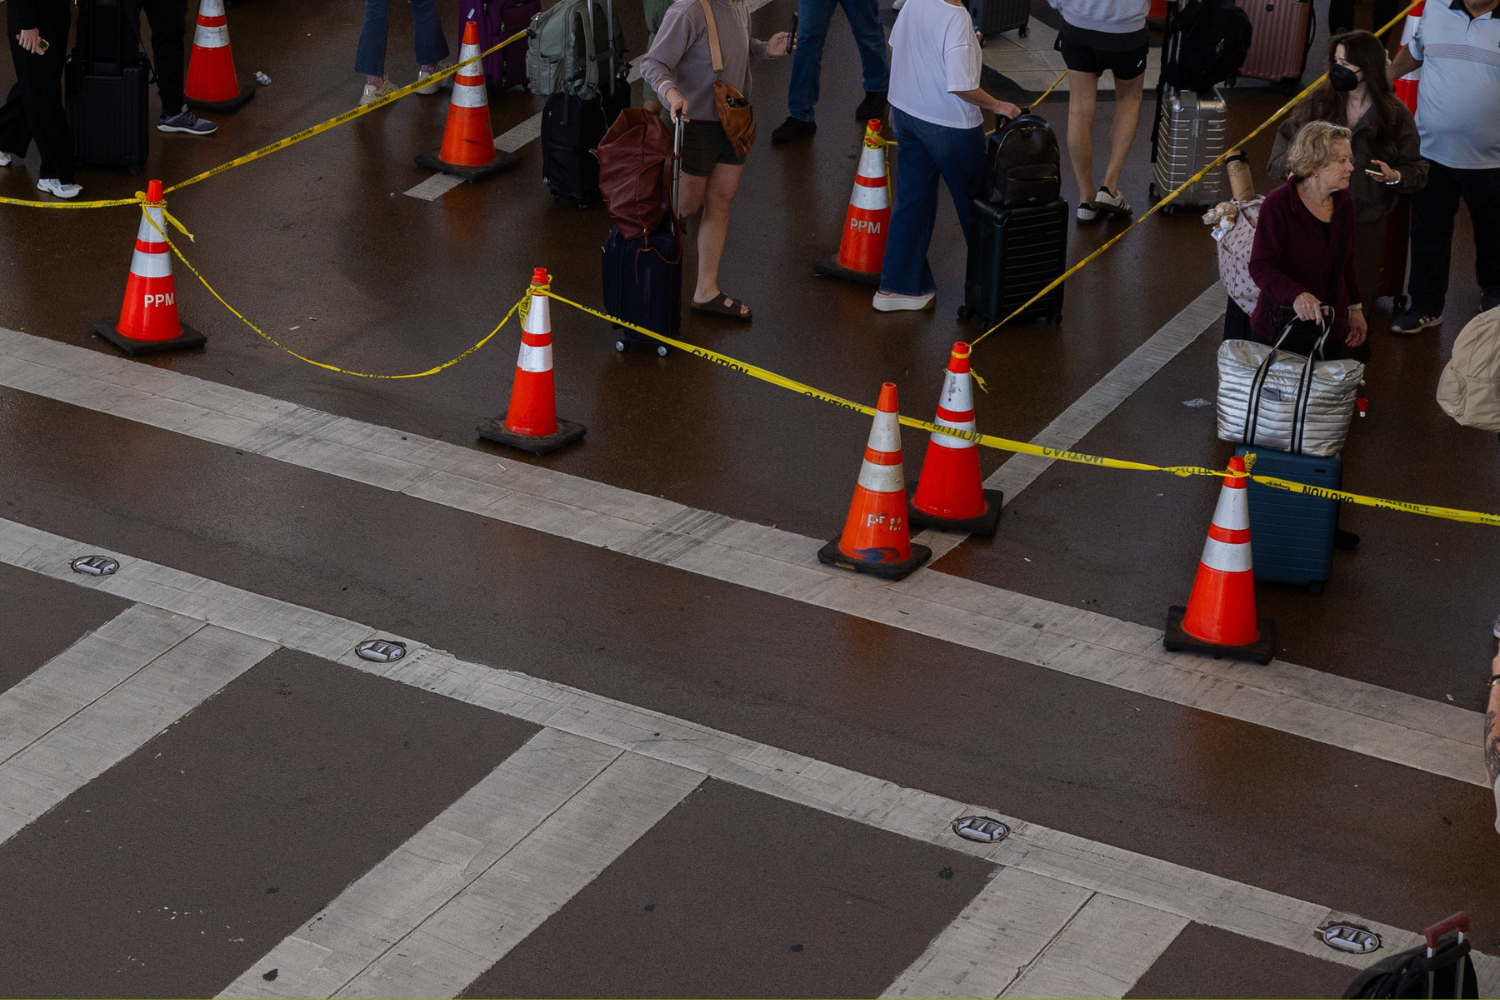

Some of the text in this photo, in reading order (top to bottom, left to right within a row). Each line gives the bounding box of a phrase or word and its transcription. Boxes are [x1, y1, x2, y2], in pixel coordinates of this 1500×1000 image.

[850, 217, 881, 235] PPM
[144, 291, 175, 308] PPM
[691, 348, 750, 374] CAUTION
